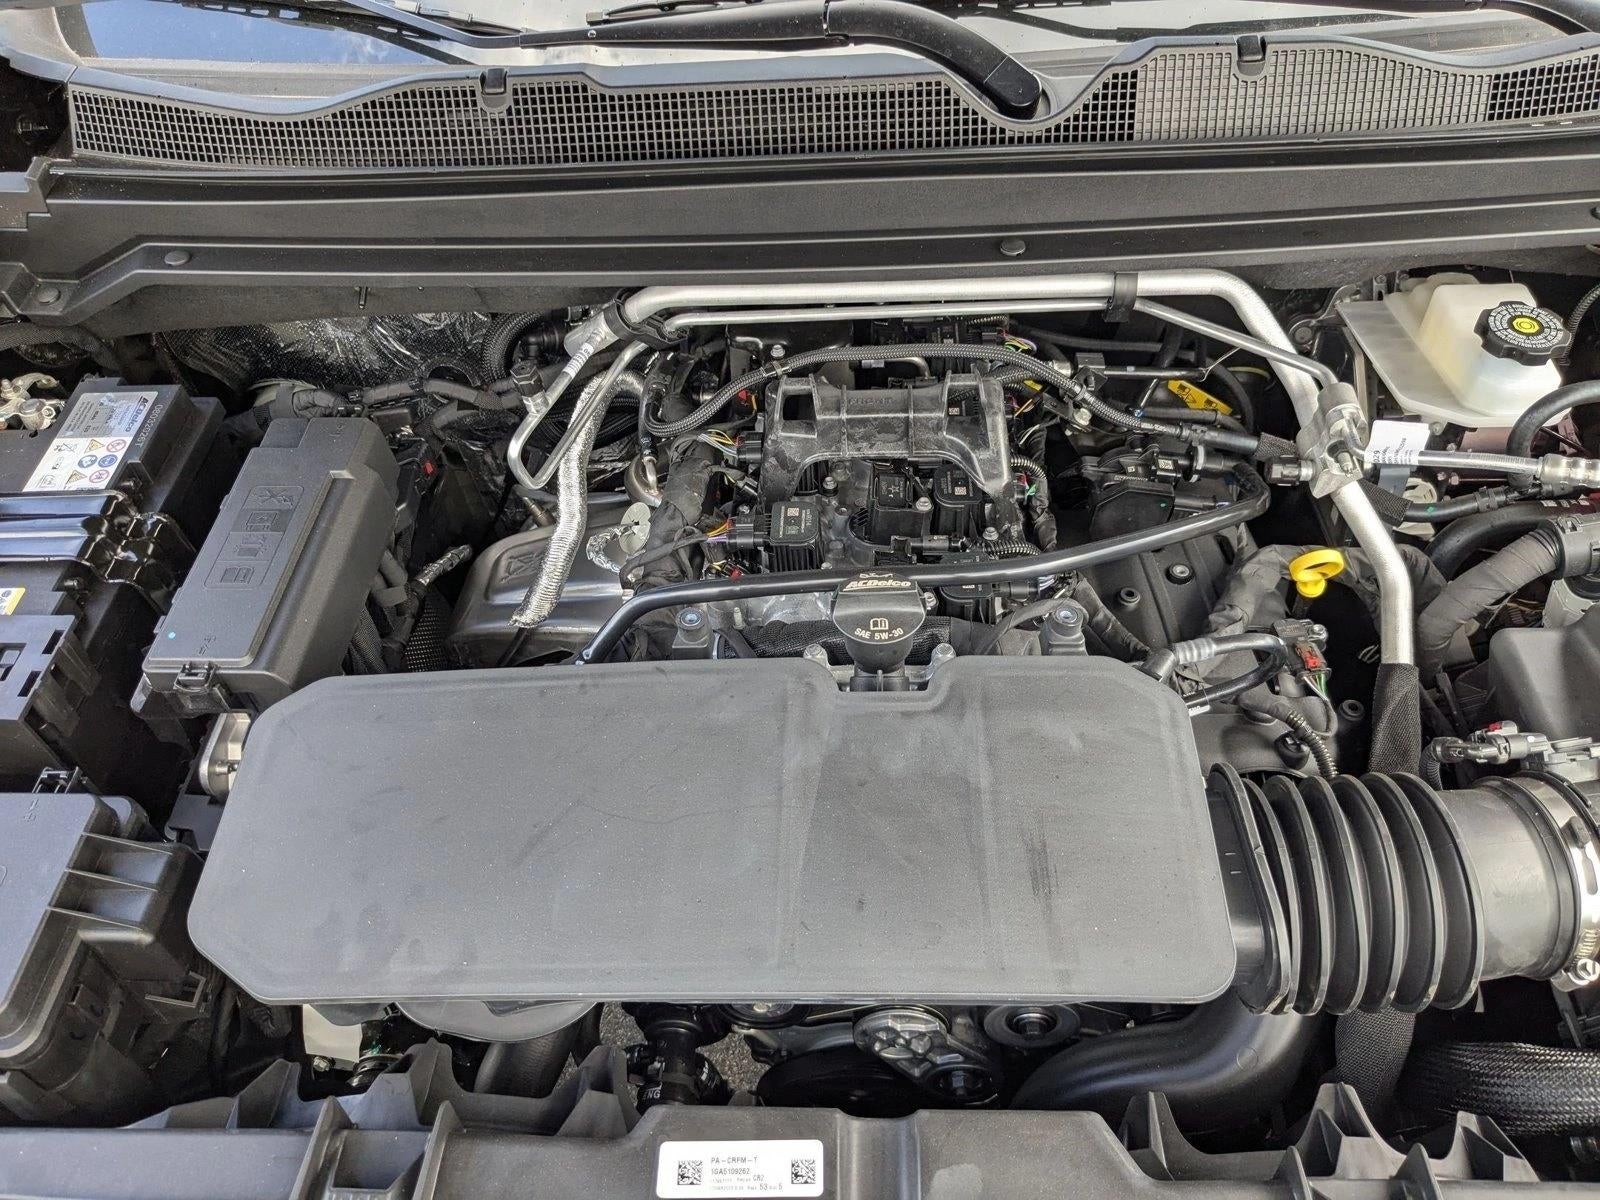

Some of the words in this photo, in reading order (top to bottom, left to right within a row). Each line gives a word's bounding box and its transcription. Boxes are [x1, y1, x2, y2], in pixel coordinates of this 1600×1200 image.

[125, 395, 149, 432] ACDelco
[843, 579, 912, 591] ACDelco
[854, 627, 872, 640] SAE
[874, 627, 904, 640] 5W-30
